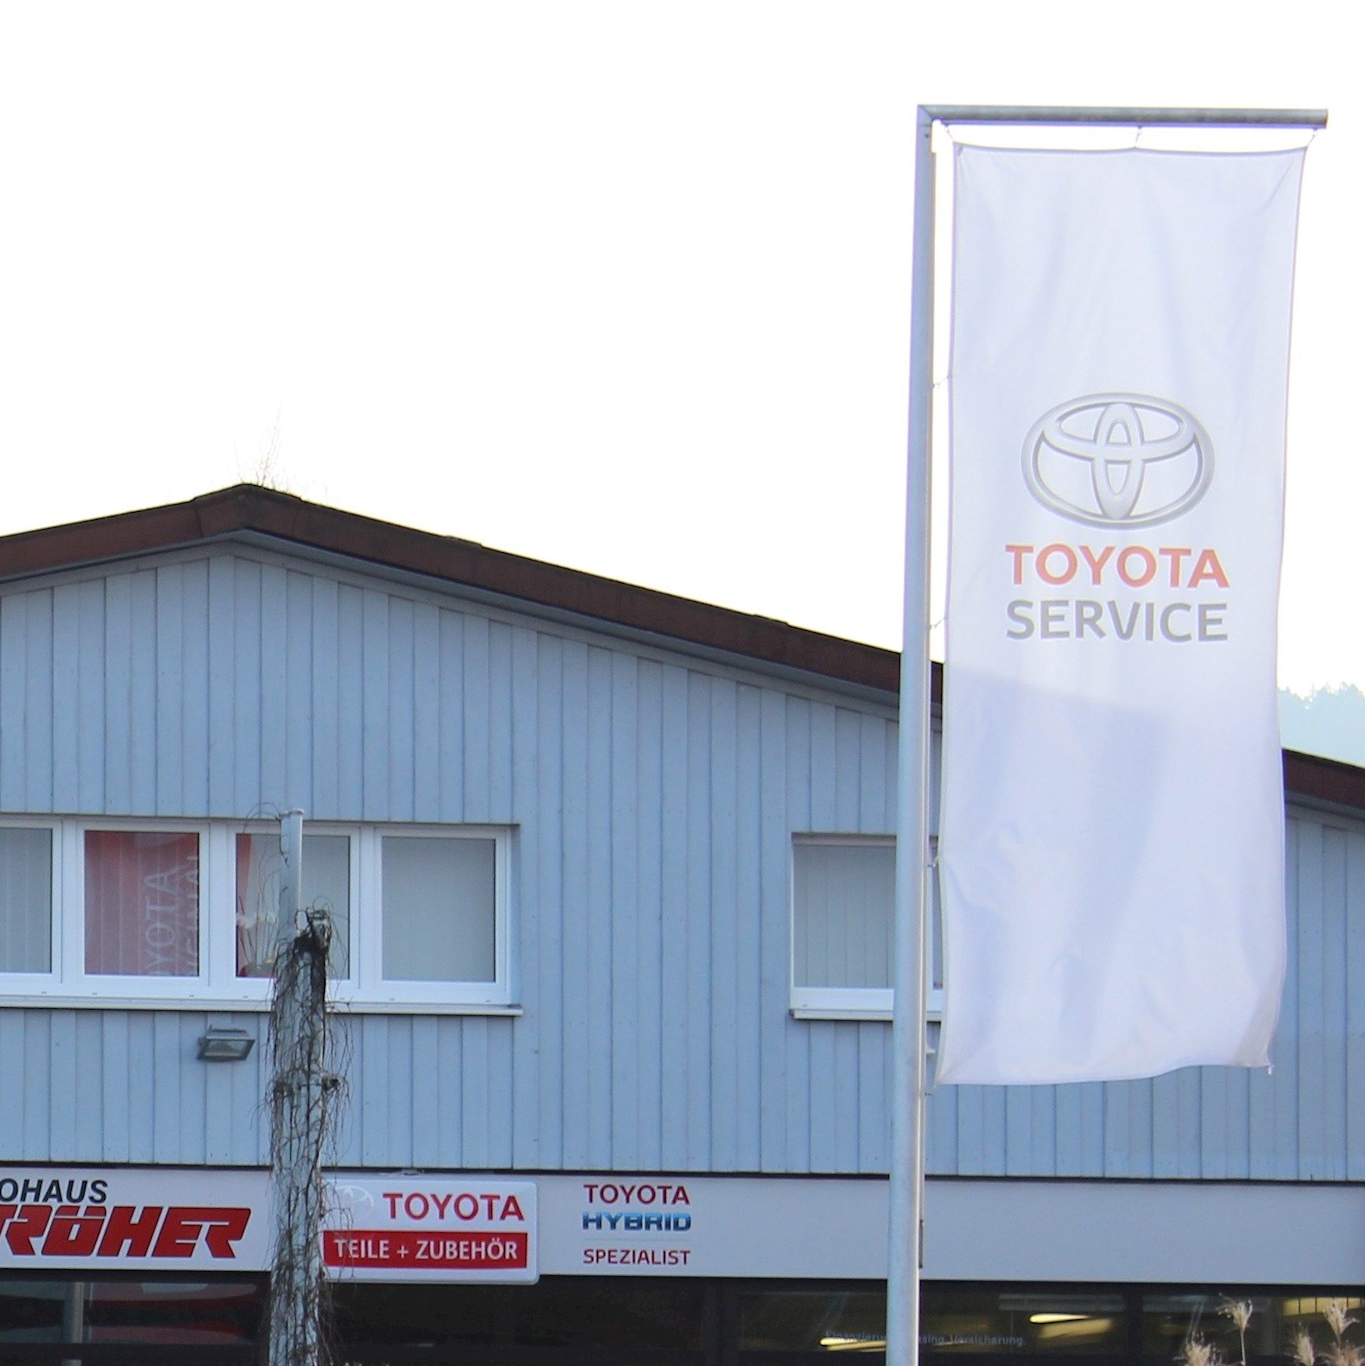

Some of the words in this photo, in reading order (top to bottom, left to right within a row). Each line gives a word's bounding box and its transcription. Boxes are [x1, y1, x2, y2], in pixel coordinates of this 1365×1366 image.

[1005, 543, 1230, 588] TOYOTA
[1005, 599, 1228, 642] SERVICE
[382, 1192, 524, 1222] TOYOTA
[582, 1184, 690, 1205] TOYOTA
[582, 1211, 691, 1232] HYBRID
[333, 1238, 390, 1260] TEILE
[415, 1234, 518, 1261] ZUBEHÖR
[582, 1248, 691, 1265] SPEZIALIST
